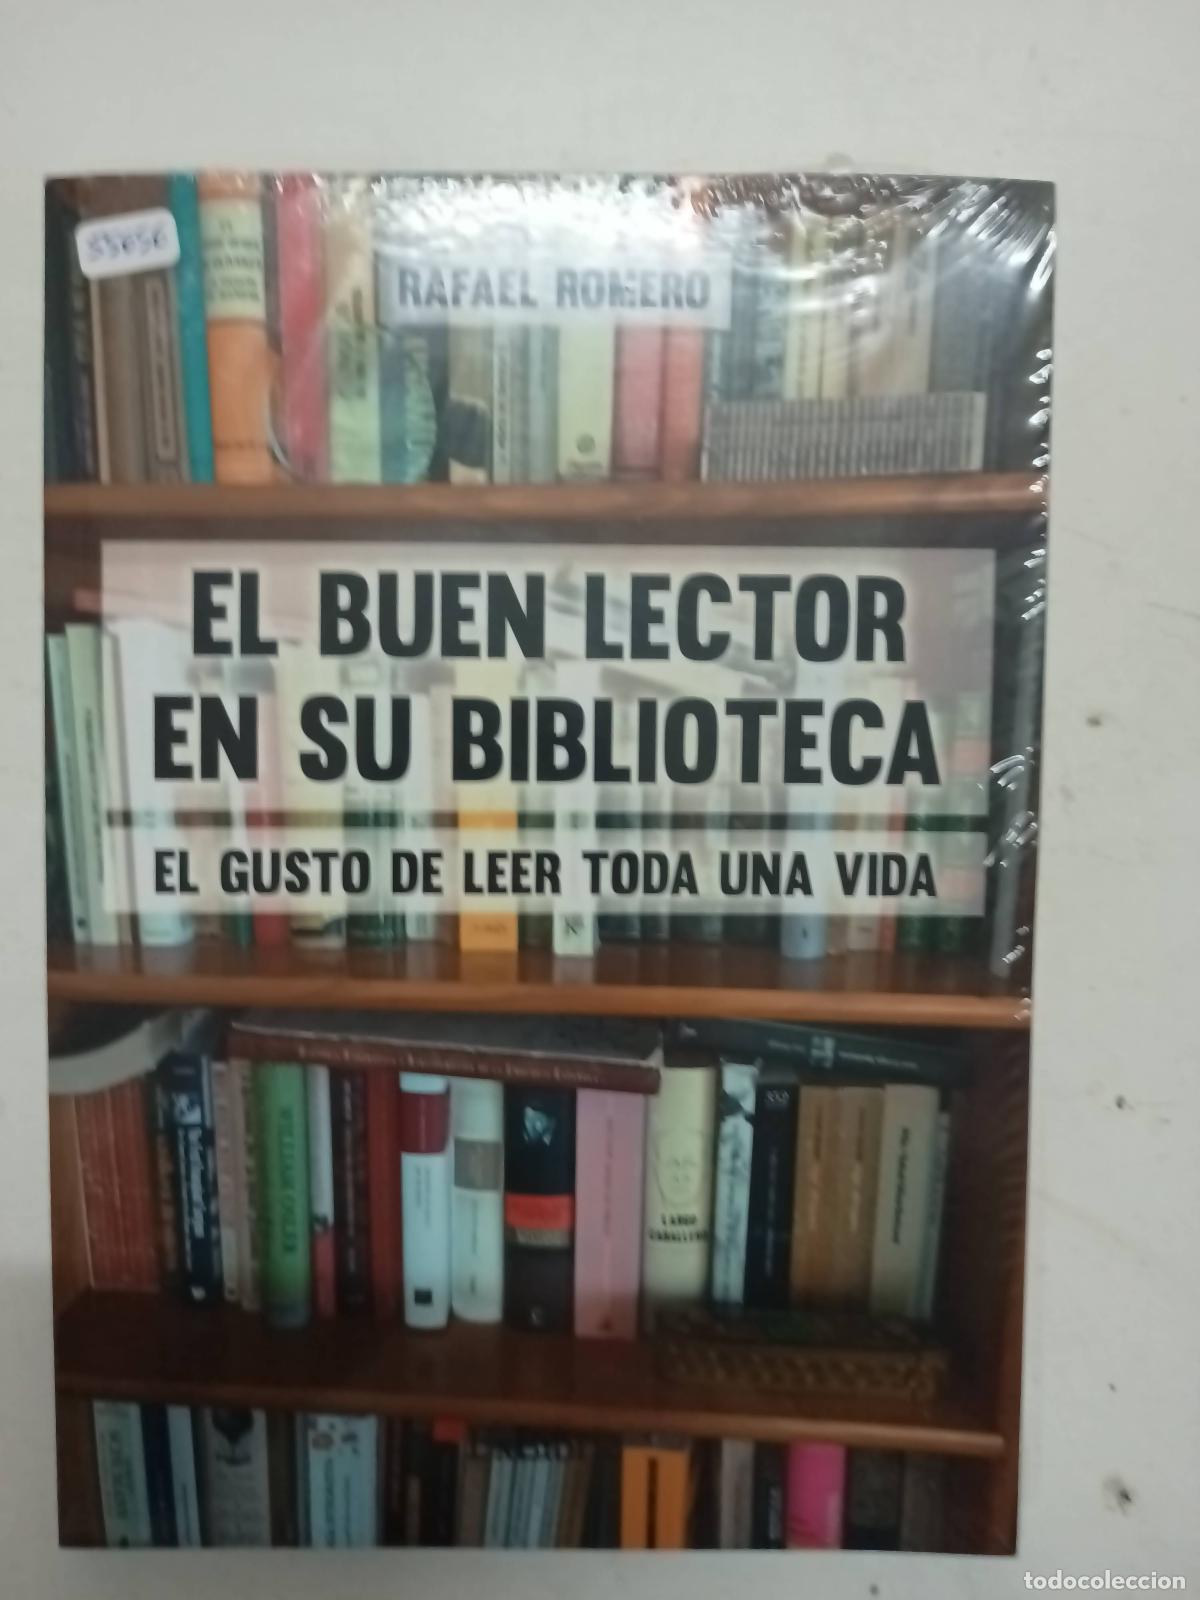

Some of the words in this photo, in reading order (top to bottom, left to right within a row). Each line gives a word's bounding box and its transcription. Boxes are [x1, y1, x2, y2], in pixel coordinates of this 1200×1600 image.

[397, 269, 538, 309] RAFAEL
[556, 268, 711, 310] ROMERO
[192, 569, 278, 657] EL
[320, 570, 546, 659] BUEN
[585, 572, 906, 662] LECTOR
[153, 695, 258, 780] EN
[299, 695, 411, 782] SU
[452, 697, 941, 786] BIBLIOTECA
[154, 850, 199, 893] EL
[220, 850, 371, 895] GUSTO
[392, 850, 443, 894] DE
[464, 851, 560, 895] LEER
[582, 851, 699, 897] TODA
[720, 851, 812, 897] UNA
[834, 852, 938, 898] VIDA
